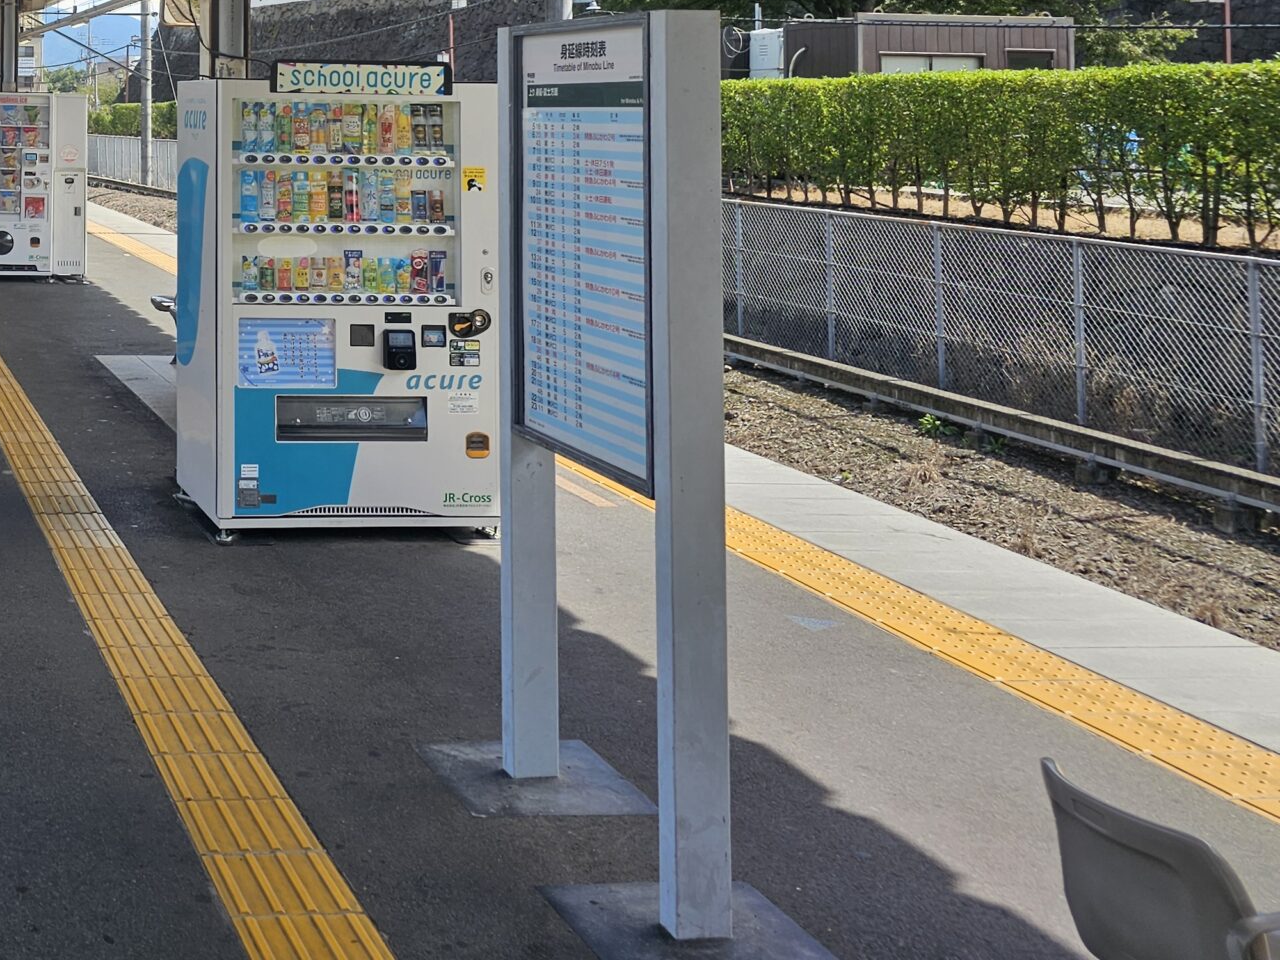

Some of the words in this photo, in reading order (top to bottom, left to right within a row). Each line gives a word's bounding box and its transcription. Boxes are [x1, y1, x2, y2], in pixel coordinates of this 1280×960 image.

[560, 40, 607, 60] 身延線時刻表
[553, 63, 577, 72] Timetable
[577, 62, 582, 72] of
[582, 61, 602, 71] Minobu
[603, 60, 615, 70] Line
[290, 68, 360, 87] school
[366, 71, 432, 89] acure
[184, 110, 207, 130] acure
[416, 169, 451, 180] acure
[406, 374, 483, 390] acure
[443, 492, 492, 503] JR-Cross
